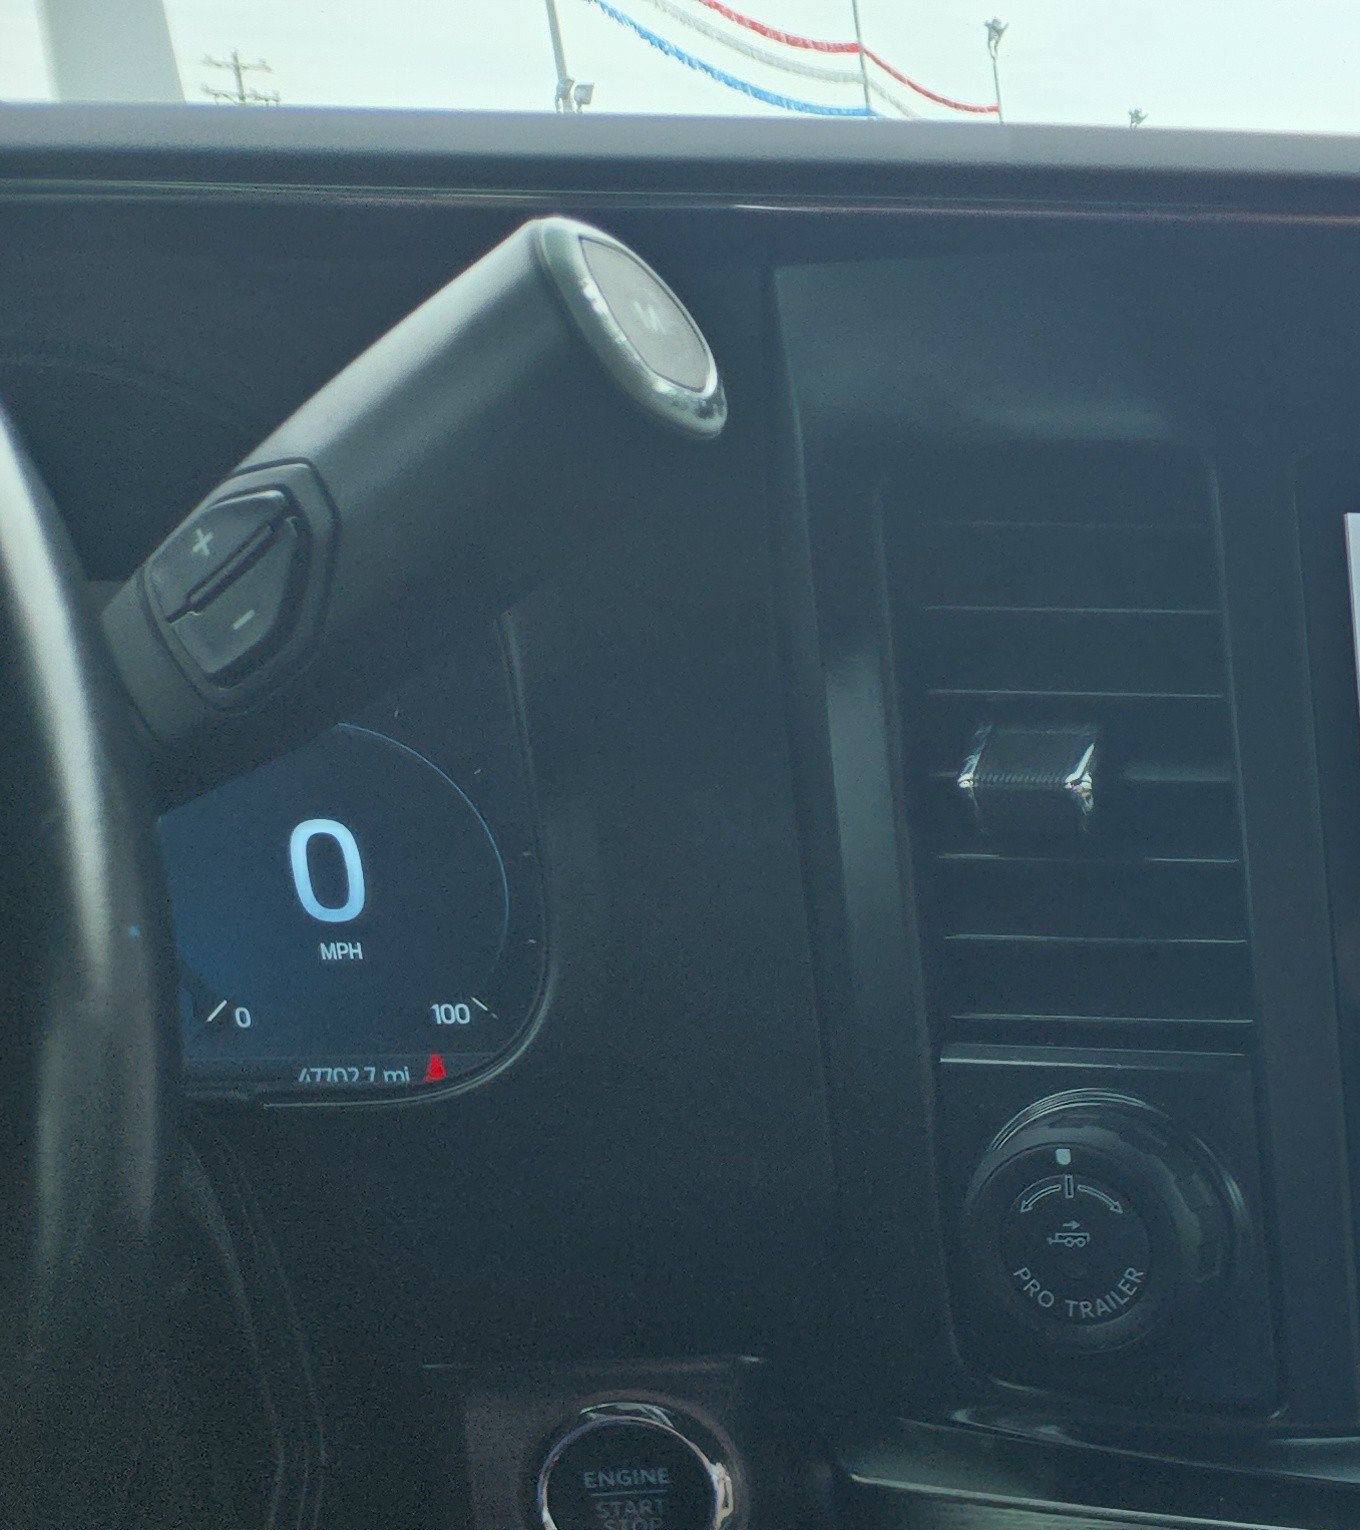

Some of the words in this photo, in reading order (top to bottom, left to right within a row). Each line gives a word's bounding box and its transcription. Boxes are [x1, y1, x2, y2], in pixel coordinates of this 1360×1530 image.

[288, 817, 367, 923] 0
[319, 941, 364, 962] MPH
[234, 1006, 252, 1028] 0
[430, 1003, 471, 1026] 100
[383, 1065, 410, 1083] mi
[1013, 1266, 1055, 1309] PRO
[1065, 1266, 1145, 1319] TRAILER
[583, 1468, 671, 1489] ENGINE
[596, 1499, 664, 1518] START
